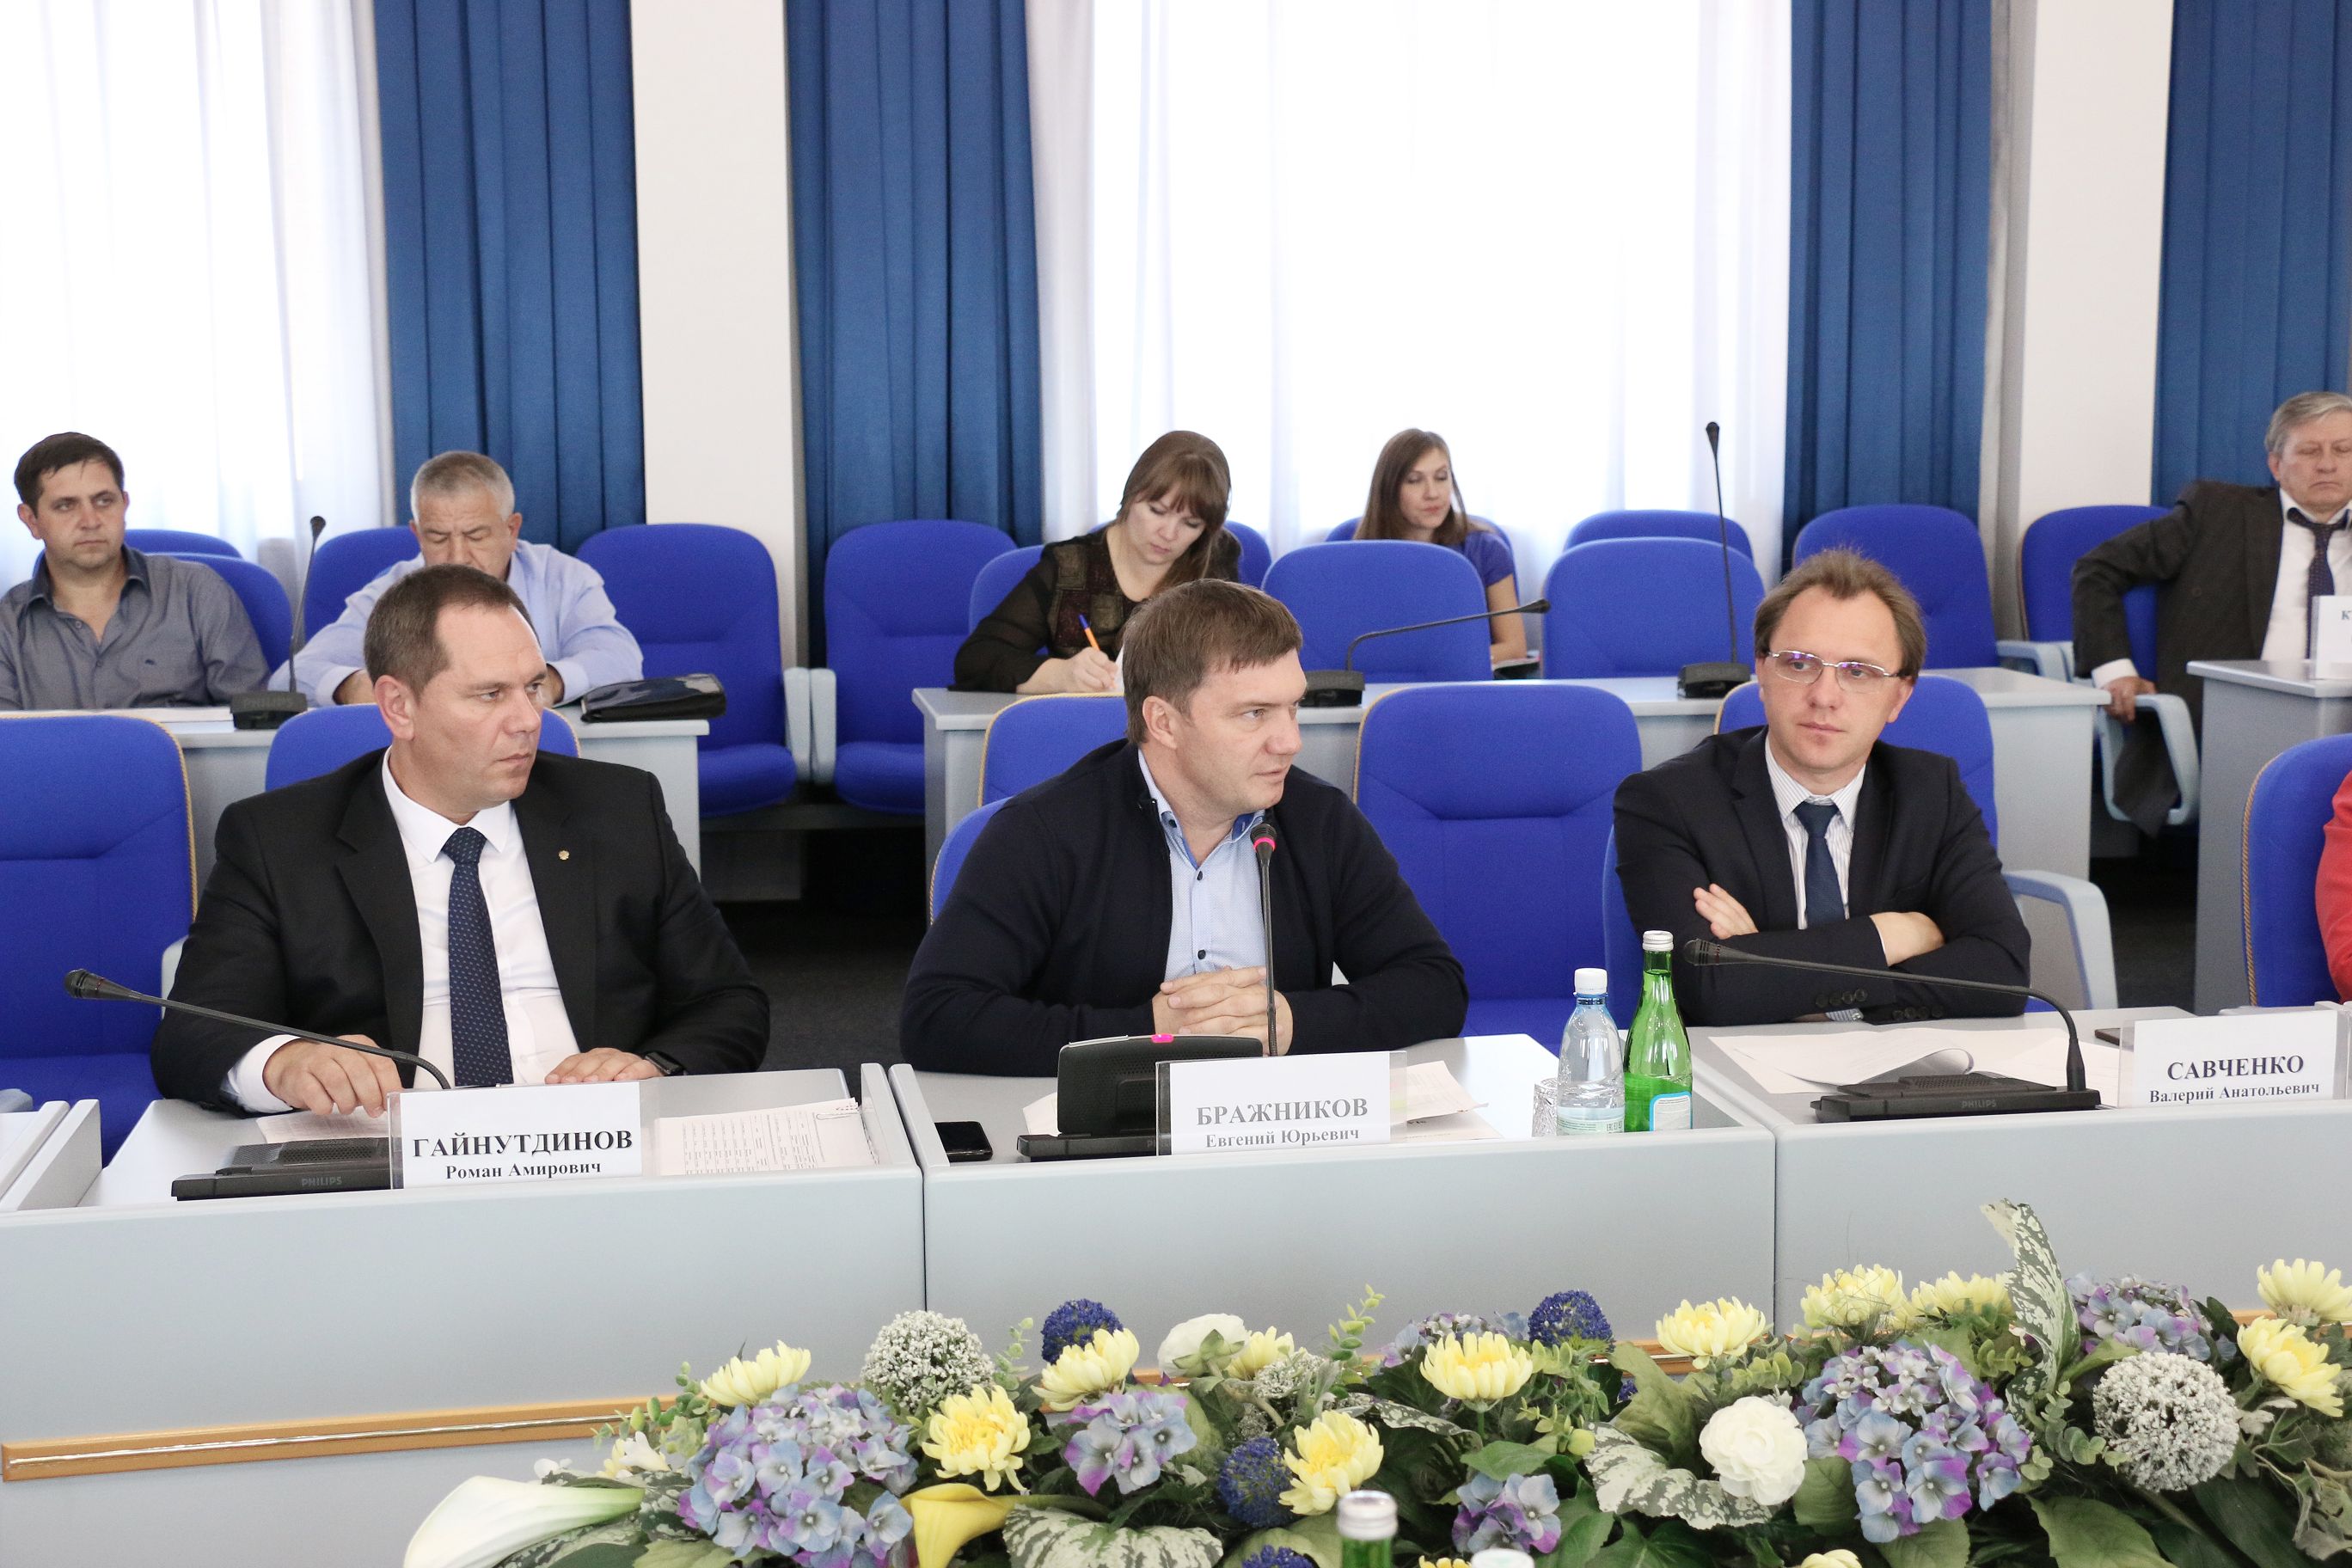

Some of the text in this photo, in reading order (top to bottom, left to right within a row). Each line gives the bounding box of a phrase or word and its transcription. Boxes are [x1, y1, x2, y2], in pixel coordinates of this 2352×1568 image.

[2166, 1054, 2305, 1081] САВЧЕНКО
[1961, 1099, 1997, 1109] PHILIPS
[2149, 1083, 2320, 1105] Валерий Анатольевич
[1196, 1097, 1369, 1126] БРАЖНИКОВ
[413, 1130, 634, 1158] ГАЙНУТДИНОВ
[1205, 1129, 1360, 1149] Евгений Юрьевич
[301, 1176, 343, 1186] PHILIPS
[445, 1162, 602, 1180] Роман Амирович
